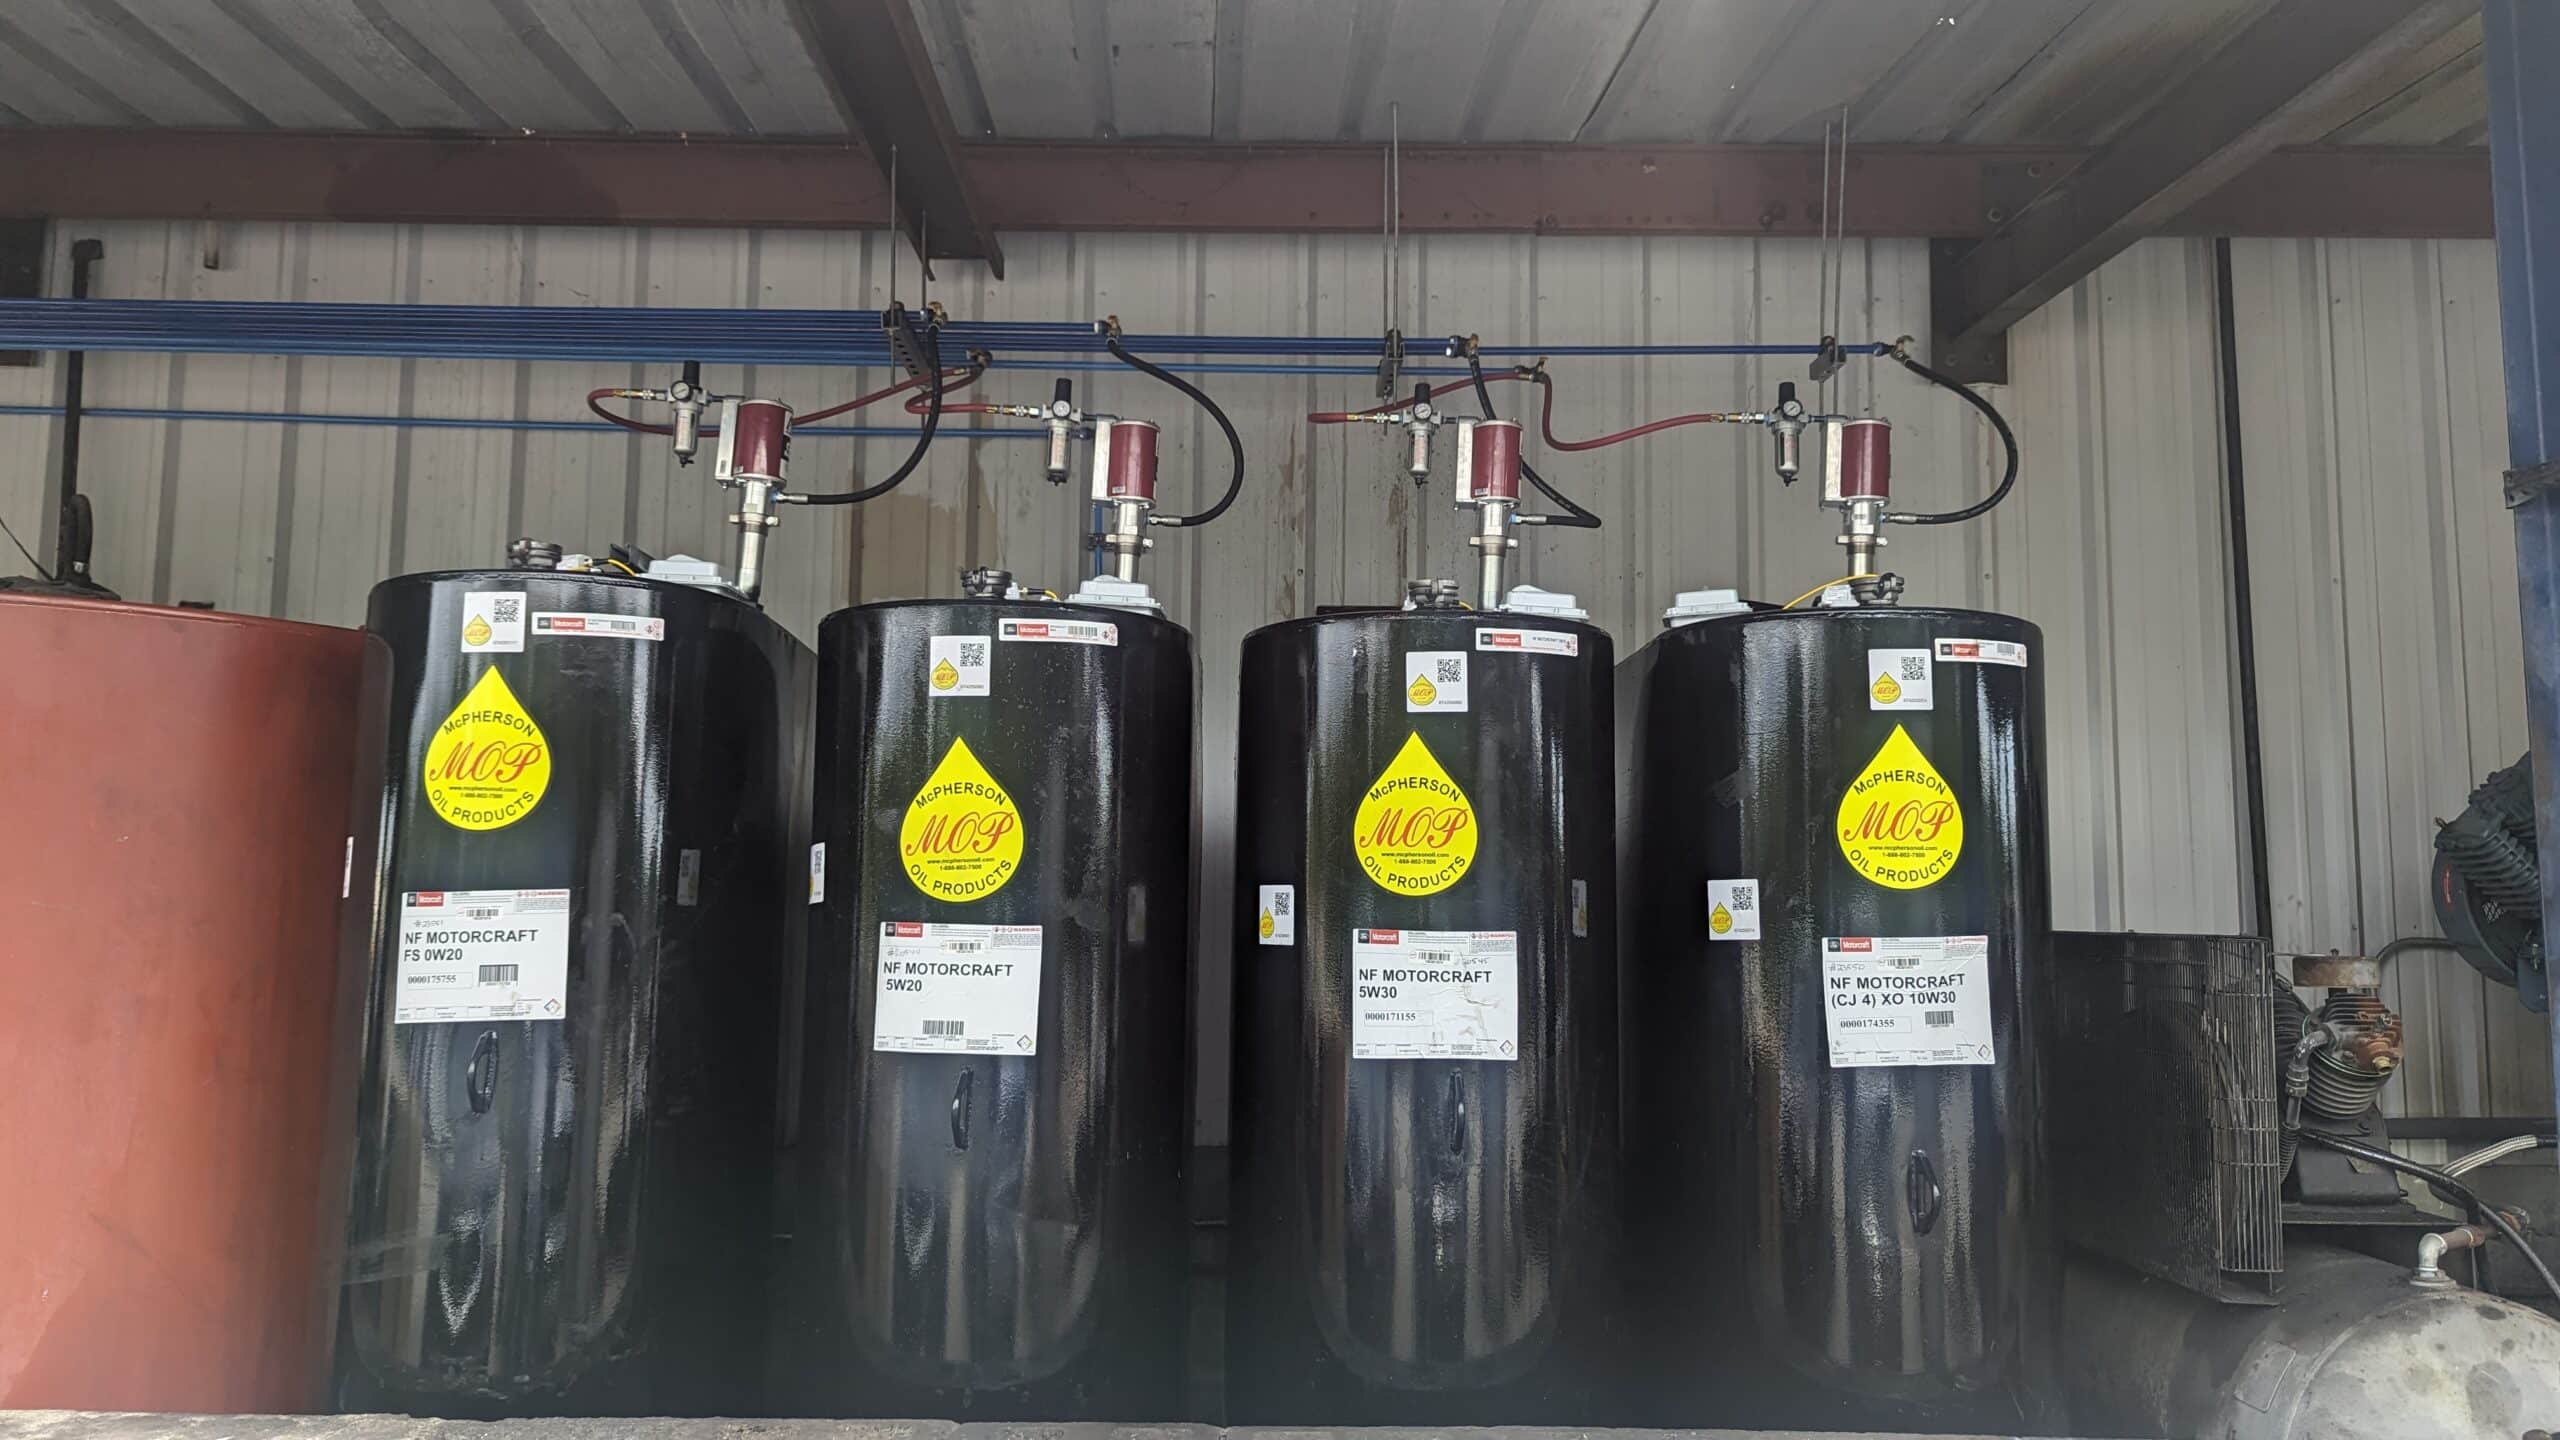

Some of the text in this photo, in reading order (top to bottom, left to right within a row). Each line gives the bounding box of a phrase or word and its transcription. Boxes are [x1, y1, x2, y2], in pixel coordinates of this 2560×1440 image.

[443, 710, 536, 737] McPHERSON
[429, 740, 543, 784] MOP
[1370, 776, 1461, 802] McPHERSON
[1853, 769, 1946, 795] McPHERSON
[432, 789, 535, 823] OIL PRODUCTS
[915, 782, 1007, 809] McPHERSON
[1359, 806, 1470, 849] MOP
[1843, 799, 1955, 842] MOP
[905, 811, 1015, 857] MOP
[910, 859, 1012, 895] OIL PRODUCTS
[1364, 855, 1466, 889] OIL PRODUCTS
[1850, 849, 1953, 882] OIL PRODUCTS
[405, 929, 539, 945] NF MOTORCRAFT
[404, 948, 463, 962] FS 0W20
[407, 974, 457, 984] 0000175755
[883, 962, 1014, 977] NF MOTORCRAFT
[1359, 968, 1493, 983] NF MOTORCRAFT
[1830, 973, 1966, 990] NF MOTORCRAFT
[886, 978, 923, 992] 5W20
[1359, 985, 1398, 999] 5W30
[1831, 991, 1956, 1008] (CJ 4) XO 10W30
[1365, 1011, 1416, 1022] 0000171155
[1840, 1019, 1895, 1029] 0000174355
